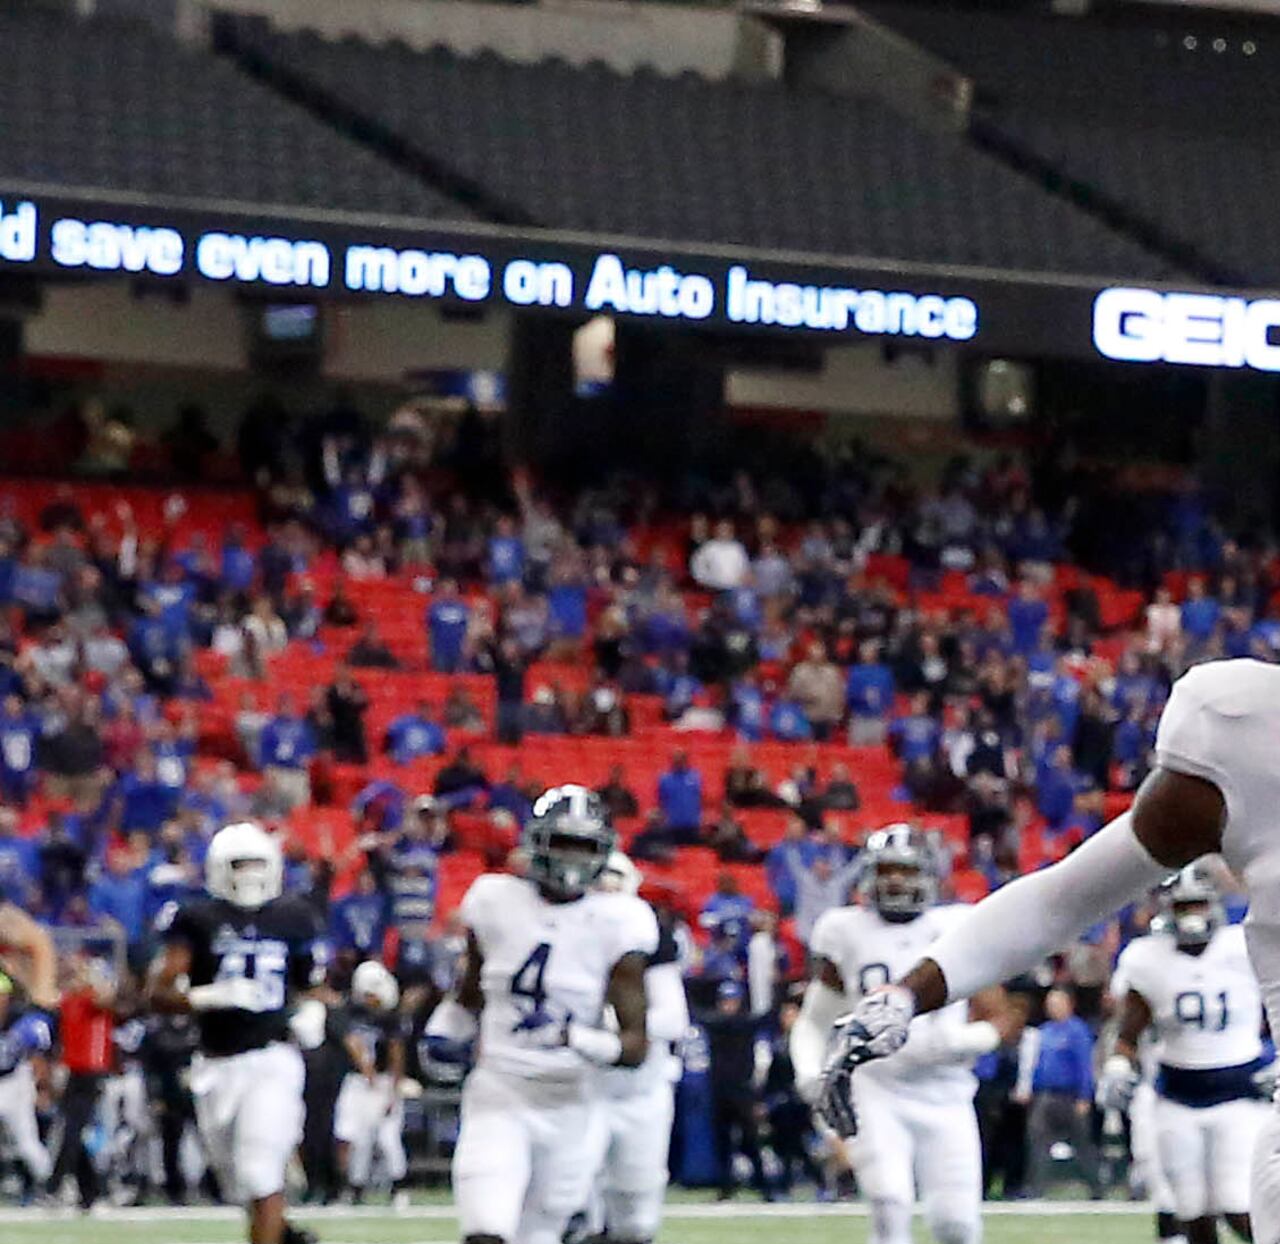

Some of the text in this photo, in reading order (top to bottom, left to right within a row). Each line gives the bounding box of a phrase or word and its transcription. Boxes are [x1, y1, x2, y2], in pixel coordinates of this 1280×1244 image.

[51, 217, 184, 275] save
[198, 232, 330, 287] even
[345, 245, 490, 301] more
[504, 259, 572, 307] on
[585, 254, 714, 320] Auto
[728, 266, 979, 341] Insurance
[510, 942, 551, 1014] 4
[1174, 990, 1228, 1032] 91
